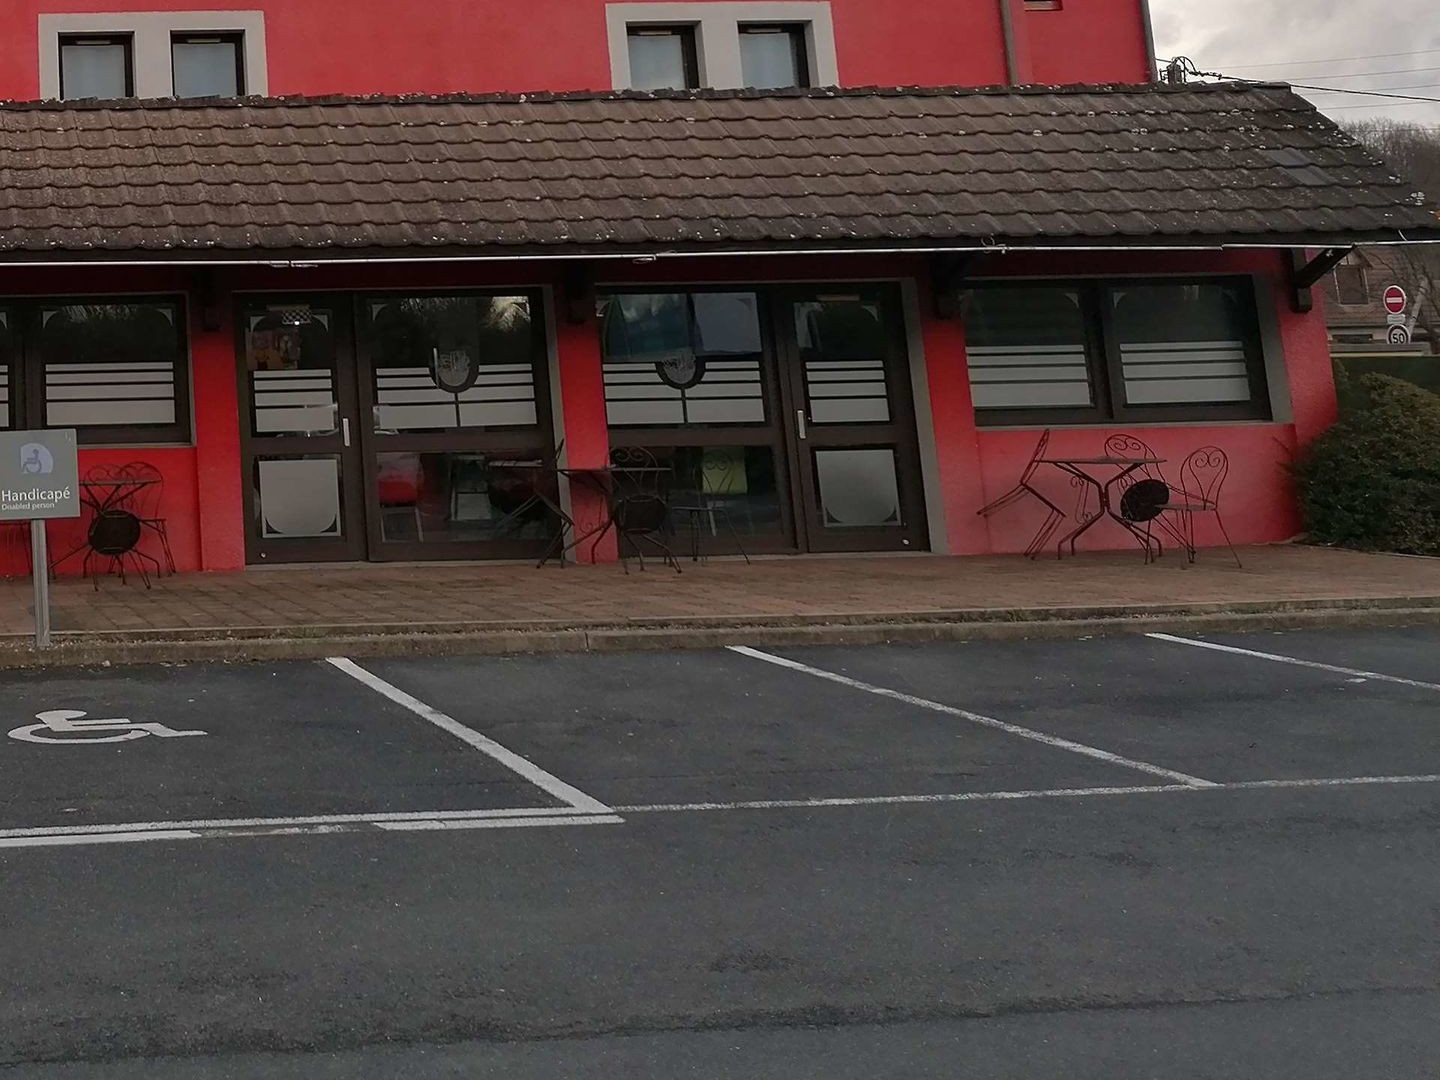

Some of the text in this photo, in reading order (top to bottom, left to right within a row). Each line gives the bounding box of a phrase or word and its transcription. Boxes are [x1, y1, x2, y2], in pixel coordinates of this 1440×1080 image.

[1392, 333, 1405, 344] 50
[1, 486, 71, 502] Handicapé
[1, 502, 55, 511] Disabled person
